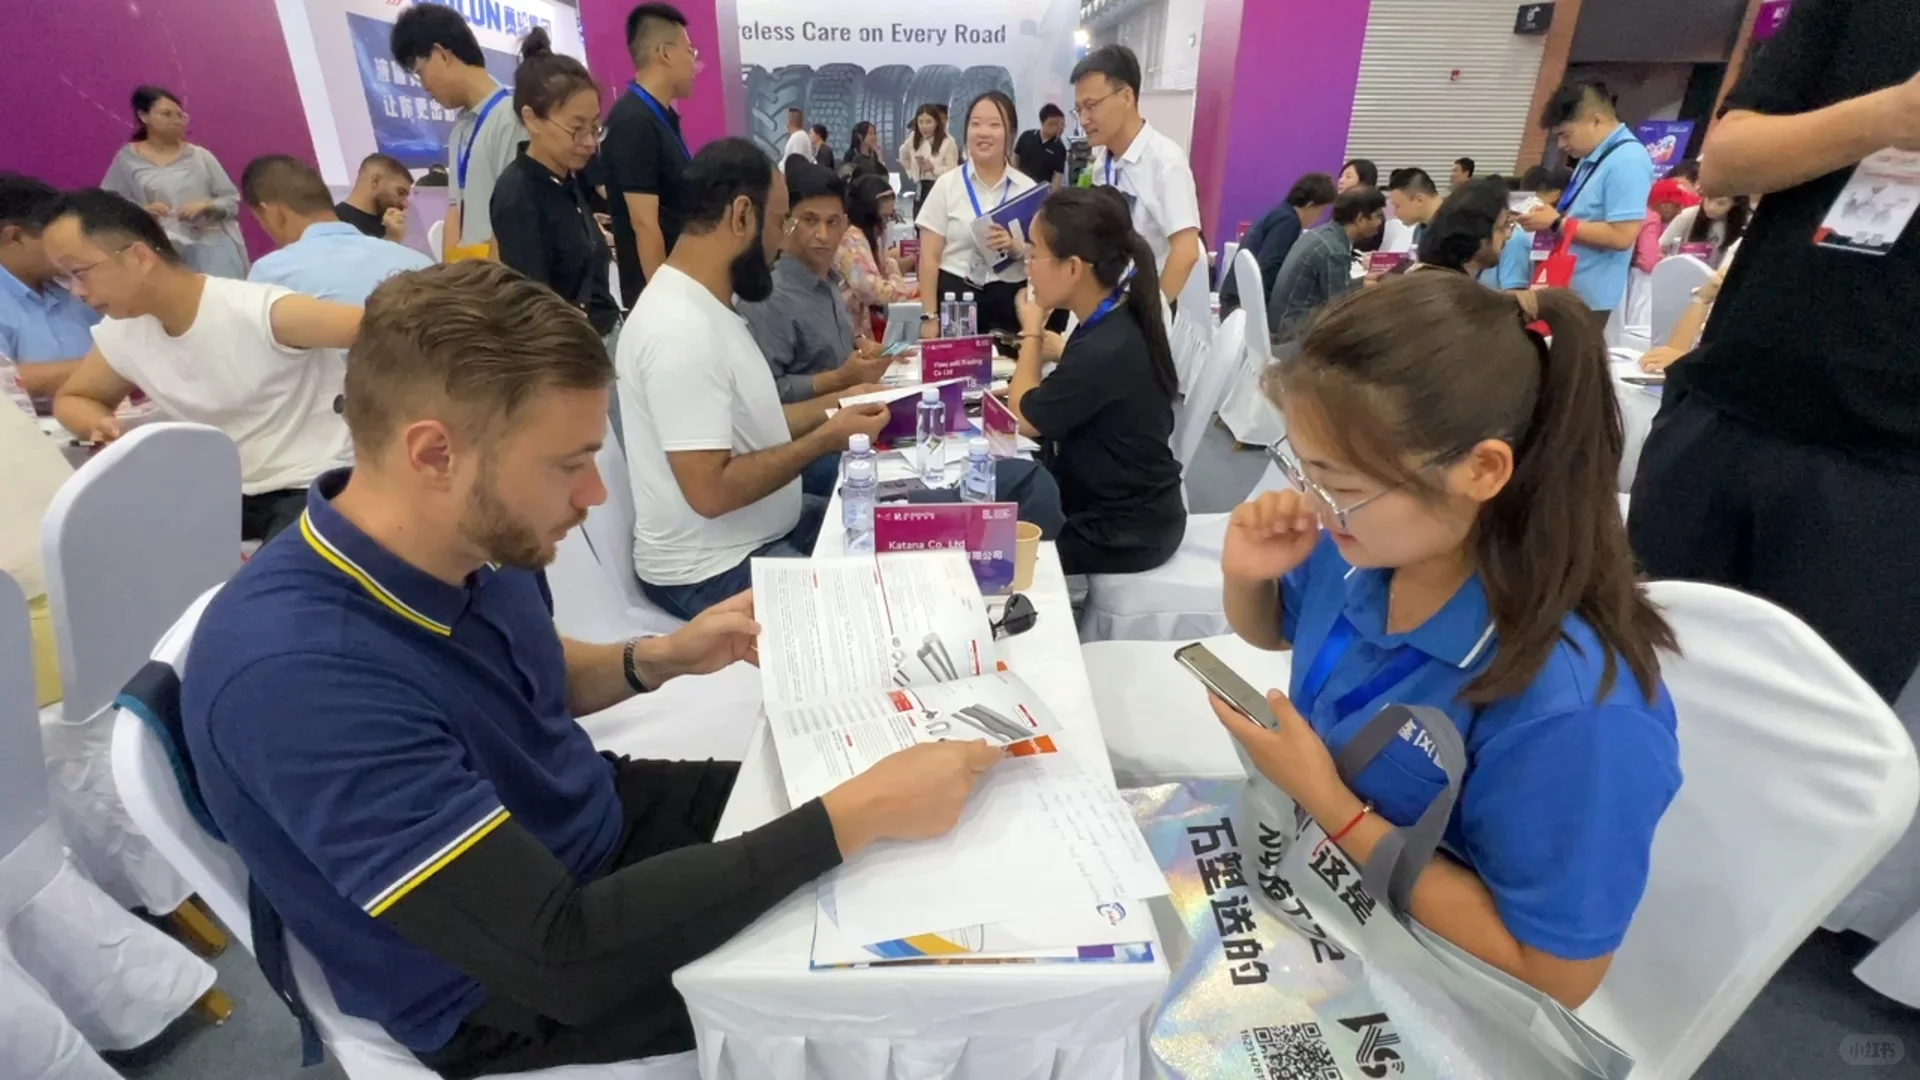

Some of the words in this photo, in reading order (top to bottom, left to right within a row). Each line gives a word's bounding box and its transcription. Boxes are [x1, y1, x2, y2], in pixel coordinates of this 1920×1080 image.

[802, 21, 851, 42] Care
[859, 27, 884, 42] on
[891, 23, 947, 47] Every
[954, 24, 1007, 44] Road
[888, 541, 925, 550] Katana
[948, 540, 966, 549] Ltd
[1186, 816, 1270, 986] 万塑送的
[1308, 845, 1377, 926] 这是
